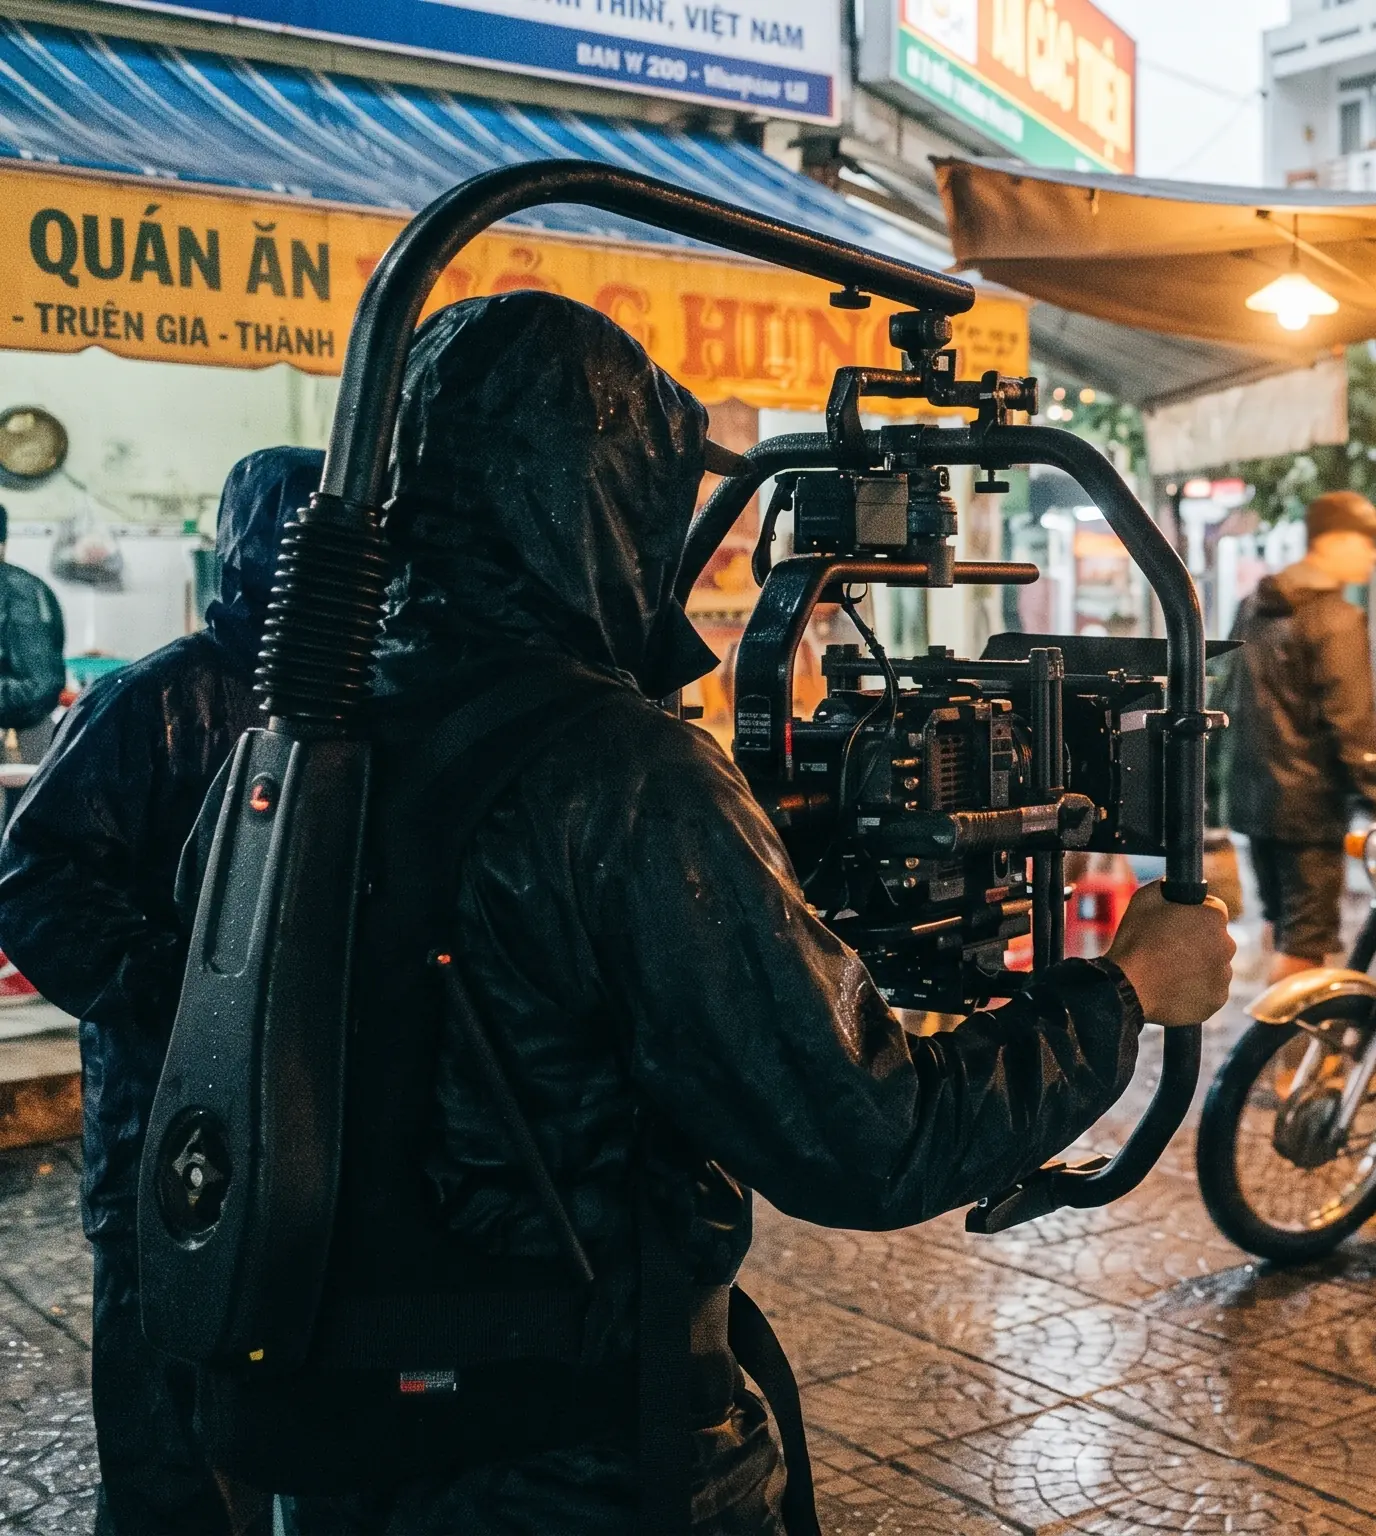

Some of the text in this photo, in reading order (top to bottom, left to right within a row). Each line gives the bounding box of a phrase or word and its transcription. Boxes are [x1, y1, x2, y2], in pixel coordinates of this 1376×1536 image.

[685, 8, 740, 41] VIỆT
[751, 18, 805, 50] NAM
[646, 54, 688, 83] 200
[29, 203, 221, 292] QUÁN
[246, 220, 331, 302] ĂN
